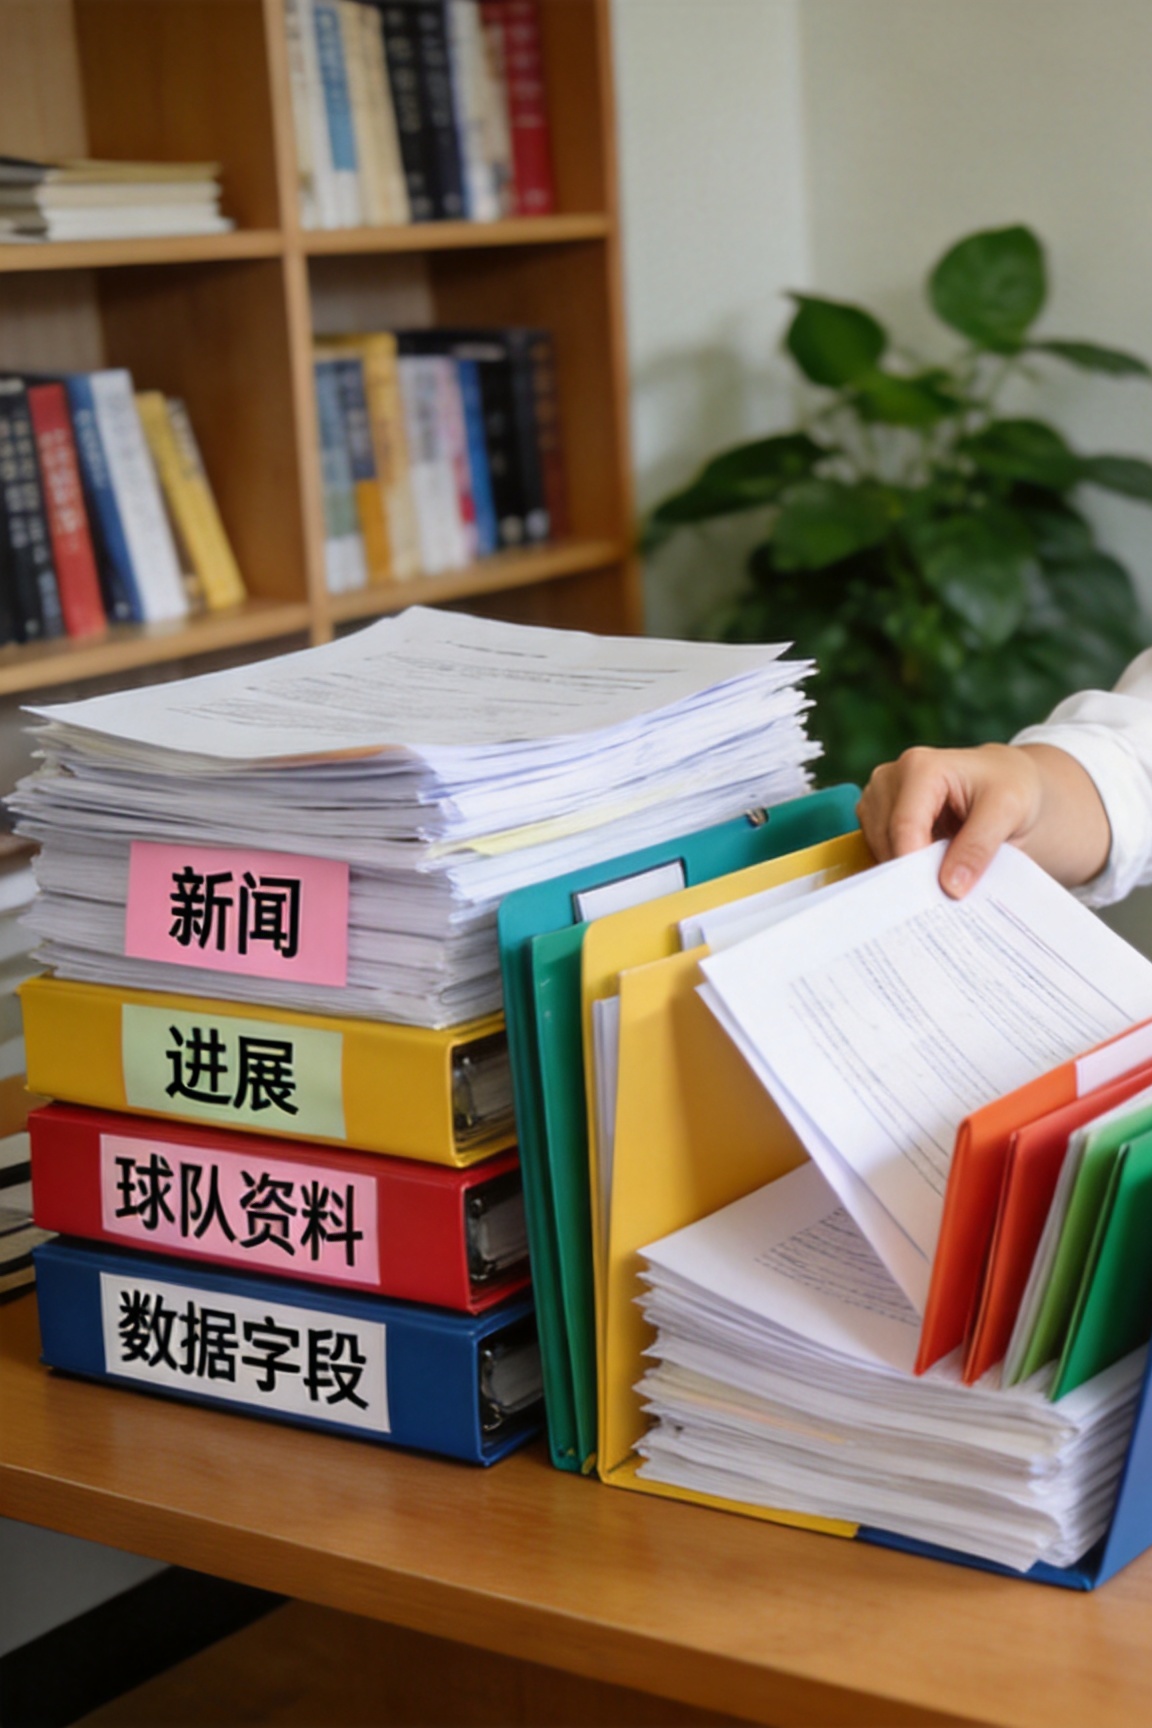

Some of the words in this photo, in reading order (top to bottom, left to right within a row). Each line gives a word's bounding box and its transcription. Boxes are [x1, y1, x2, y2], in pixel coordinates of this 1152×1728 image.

[168, 865, 302, 959] 新闻
[165, 1025, 299, 1116] 进展
[114, 1153, 364, 1267] 球队资料
[118, 1289, 370, 1411] 数据字段
